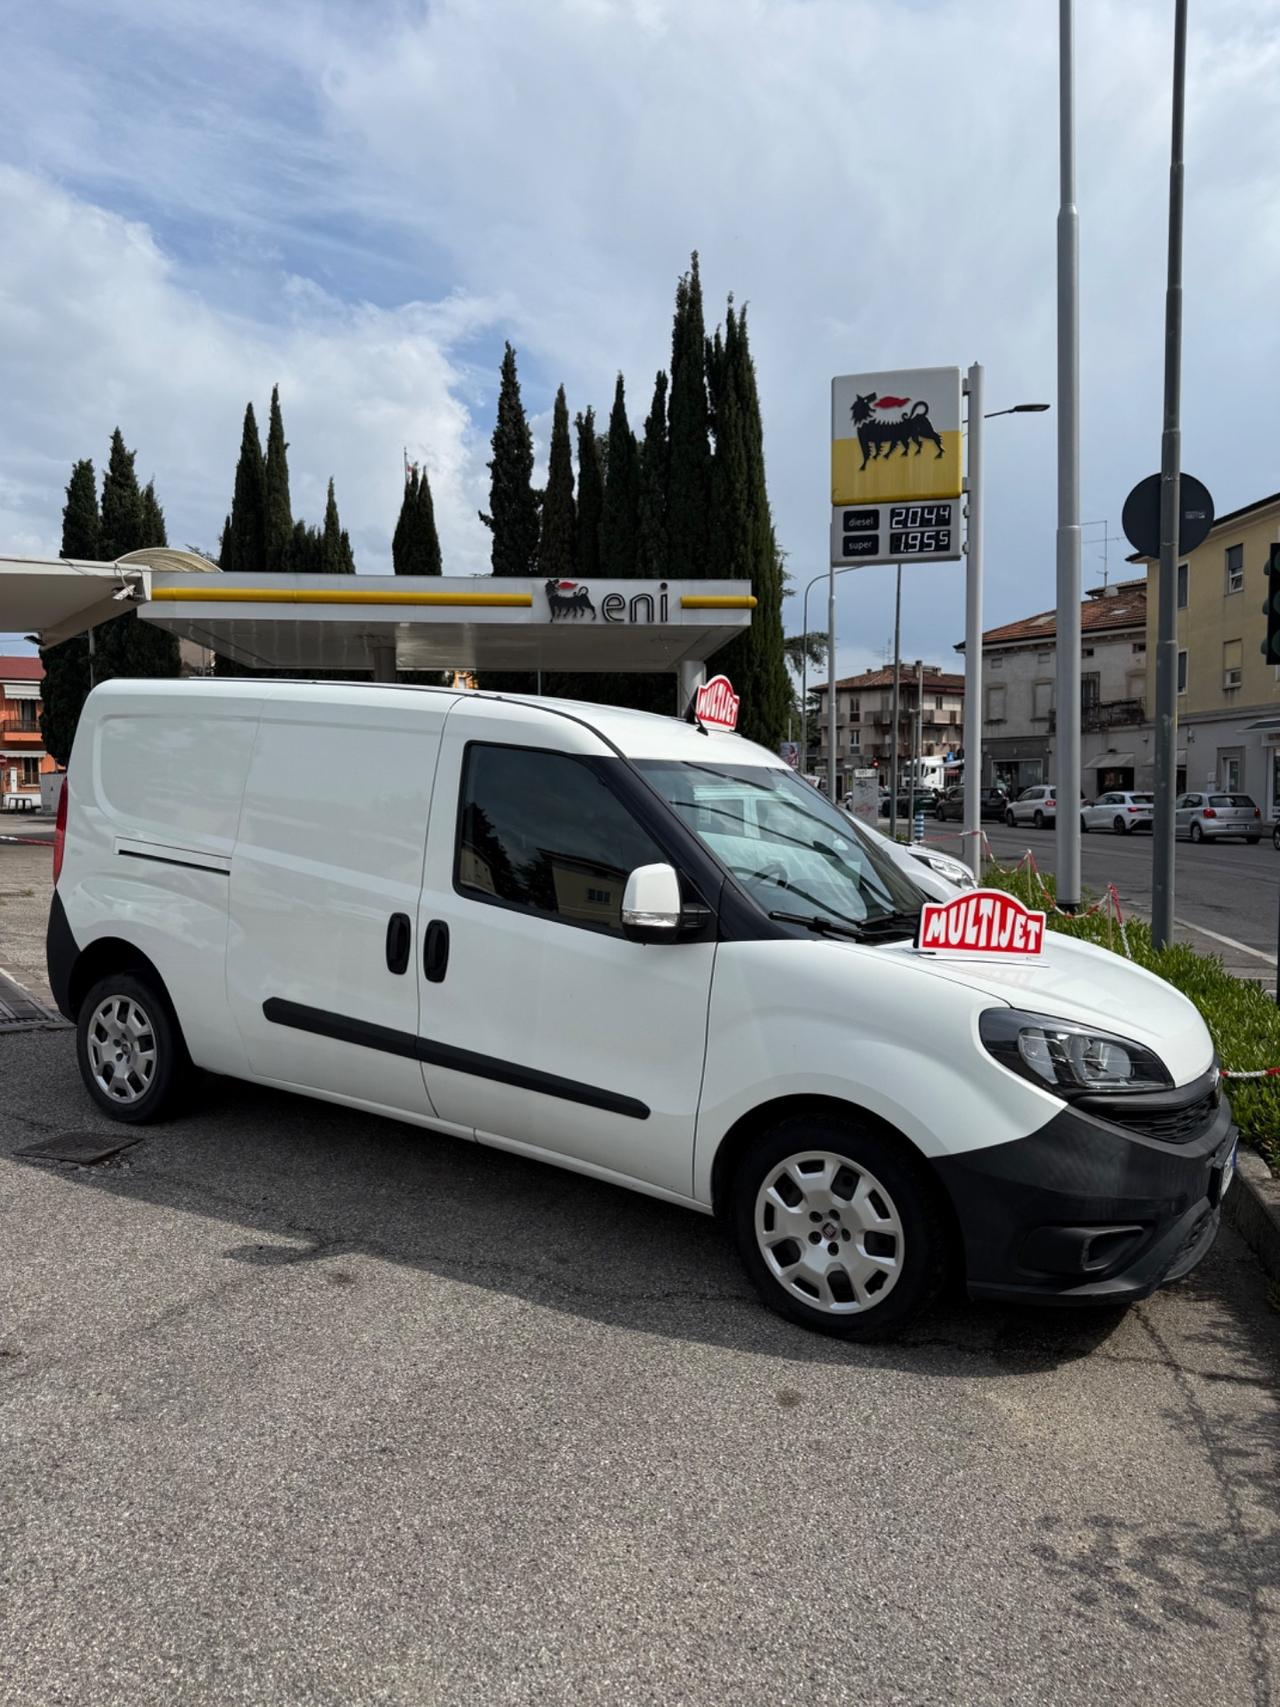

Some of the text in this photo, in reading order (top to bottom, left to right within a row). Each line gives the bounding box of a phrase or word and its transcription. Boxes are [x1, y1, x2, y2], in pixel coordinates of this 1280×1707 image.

[848, 516, 874, 527] diesel
[848, 541, 872, 551] super
[602, 582, 668, 623] eni
[698, 681, 737, 725] MULTIJET
[925, 897, 1042, 951] MULTIJET
